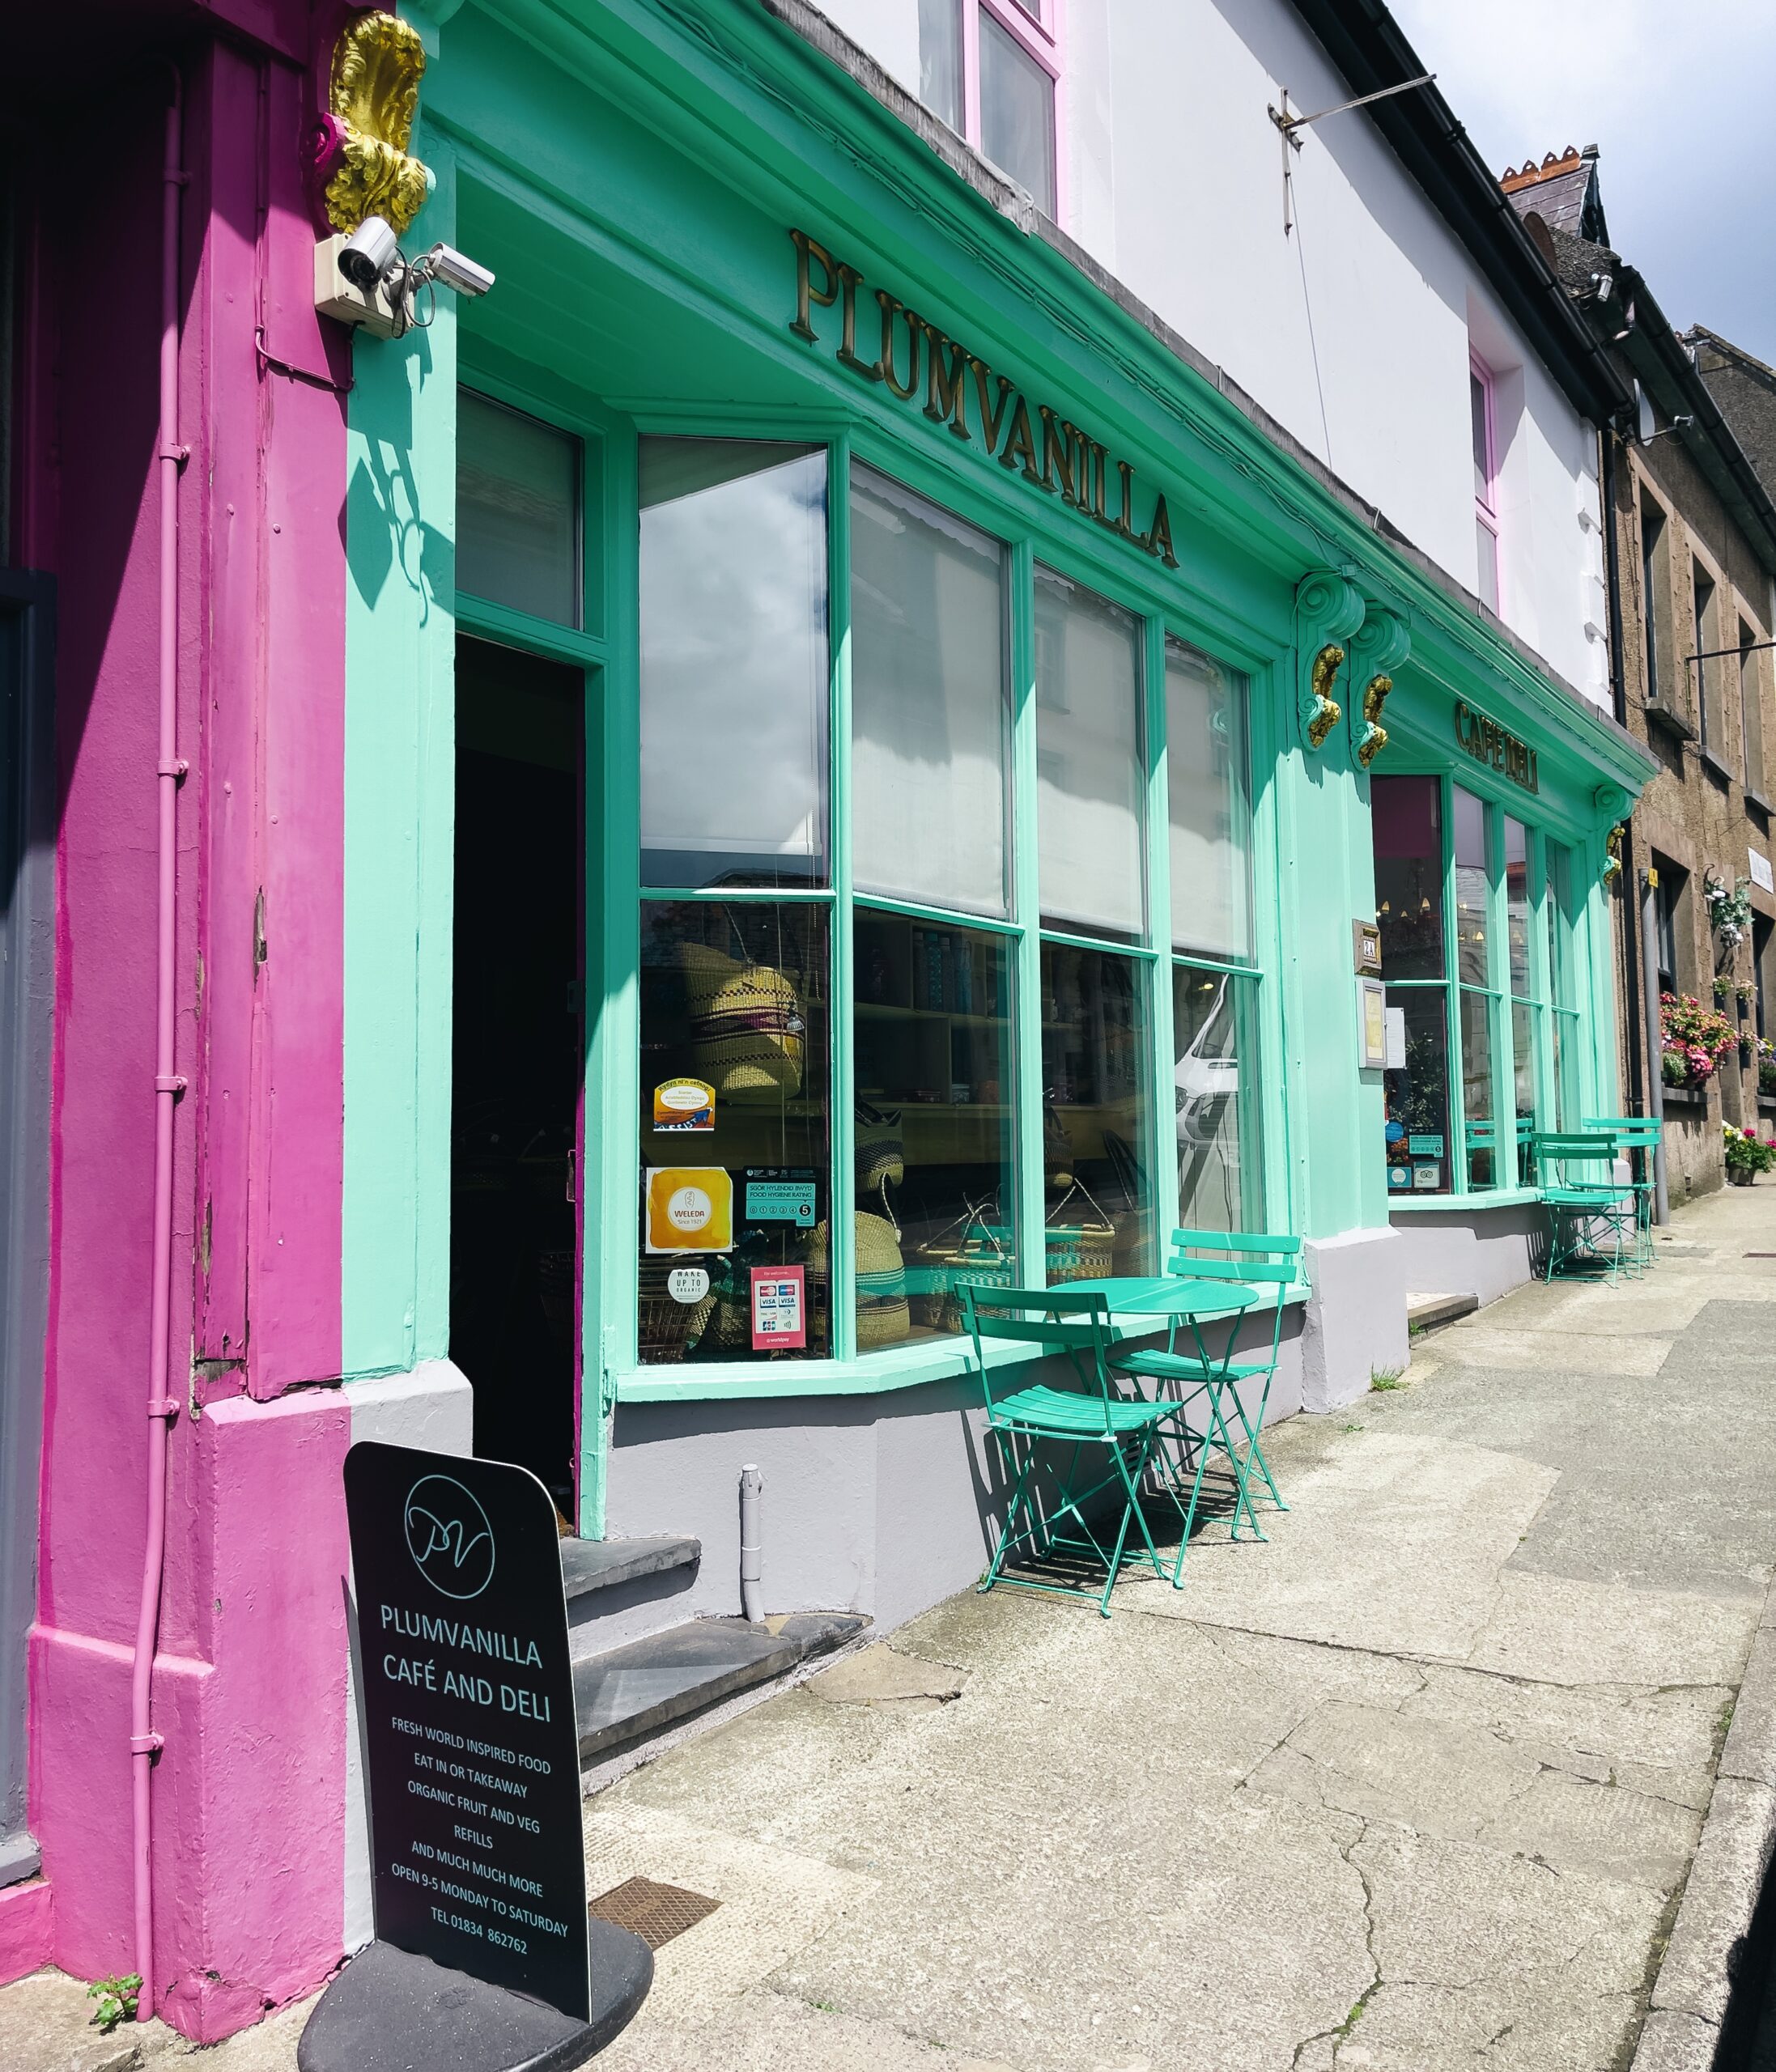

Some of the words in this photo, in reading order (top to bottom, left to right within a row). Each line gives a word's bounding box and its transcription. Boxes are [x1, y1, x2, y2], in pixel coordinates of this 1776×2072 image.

[788, 227, 1180, 569] PLUMVANILLA
[801, 1206, 809, 1215] 5
[380, 1604, 543, 1669] PLUMVANILLA
[384, 1654, 437, 1692] CAFÉ
[444, 1671, 493, 1705] AND
[500, 1685, 550, 1722] DELI
[392, 1717, 423, 1737] FRESH
[425, 1726, 464, 1748] WORLD
[467, 1739, 515, 1764] INSPIRED
[519, 1754, 550, 1774] FOOD
[414, 1752, 433, 1769] EAT
[436, 1759, 446, 1773] IN
[449, 1764, 465, 1780] OR
[467, 1768, 527, 1798] TAKEAWAY
[408, 1781, 455, 1807] ORGANIC
[457, 1796, 487, 1816] FRUIT
[491, 1807, 515, 1825] AND
[516, 1815, 540, 1833] VEG
[454, 1825, 493, 1849] REFILLS
[412, 1841, 434, 1858] AND
[436, 1849, 469, 1871] MUCH
[473, 1862, 506, 1884] MUCH
[509, 1874, 543, 1897] MORE
[392, 1863, 419, 1884] OPEN
[422, 1874, 439, 1890] 9-5
[440, 1880, 489, 1909] MONDAY
[491, 1898, 507, 1915] TO
[508, 1905, 568, 1938] SATURDAY
[431, 1906, 449, 1925] TEL
[451, 1914, 483, 1938] 01834
[487, 1929, 527, 1955] 862762
